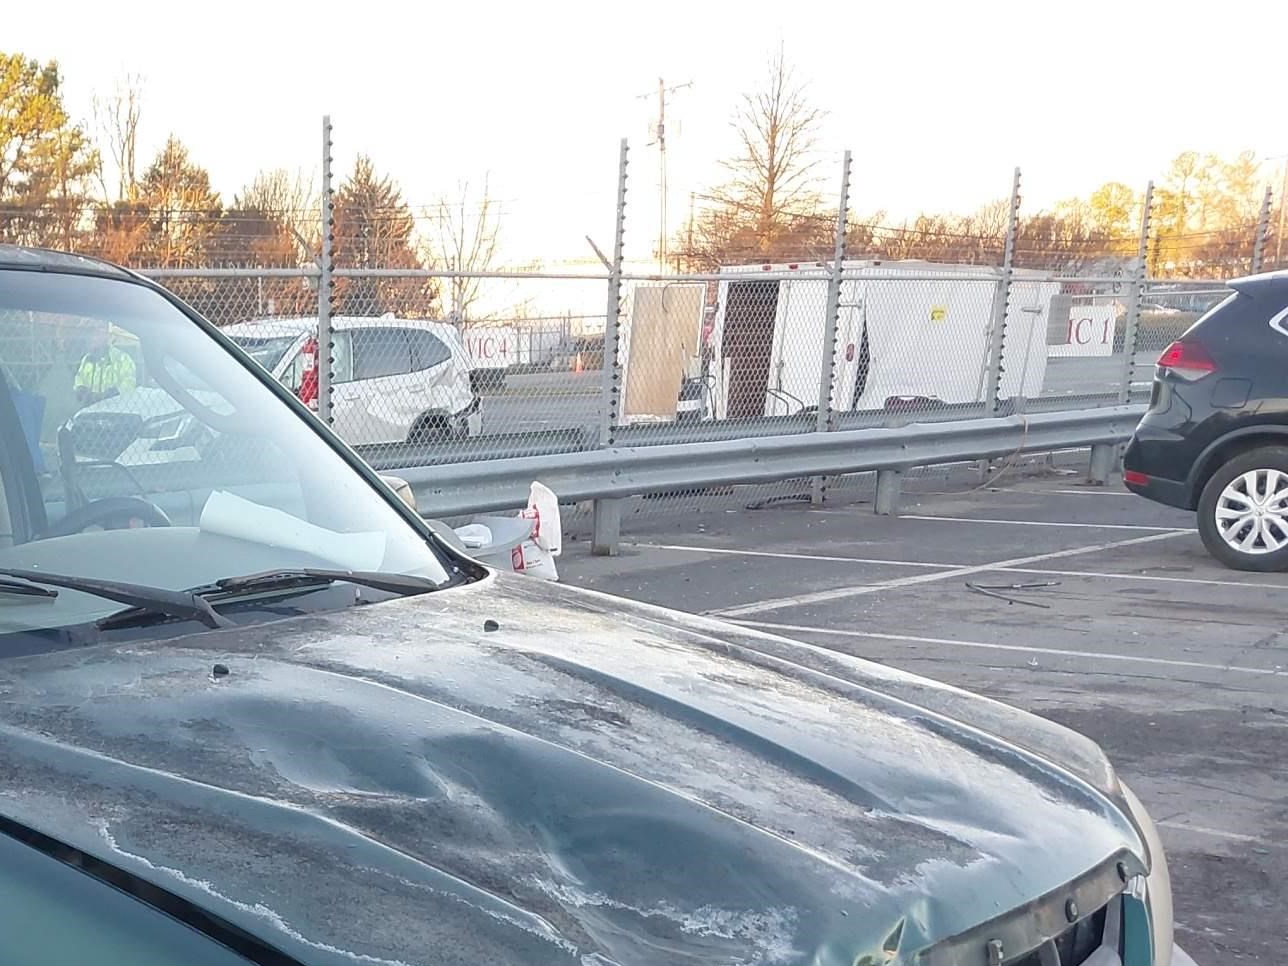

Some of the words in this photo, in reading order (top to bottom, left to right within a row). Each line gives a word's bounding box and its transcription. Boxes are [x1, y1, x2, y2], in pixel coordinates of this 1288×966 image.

[1066, 318, 1093, 345] IC
[467, 337, 494, 359] VIC
[499, 337, 507, 358] 4
